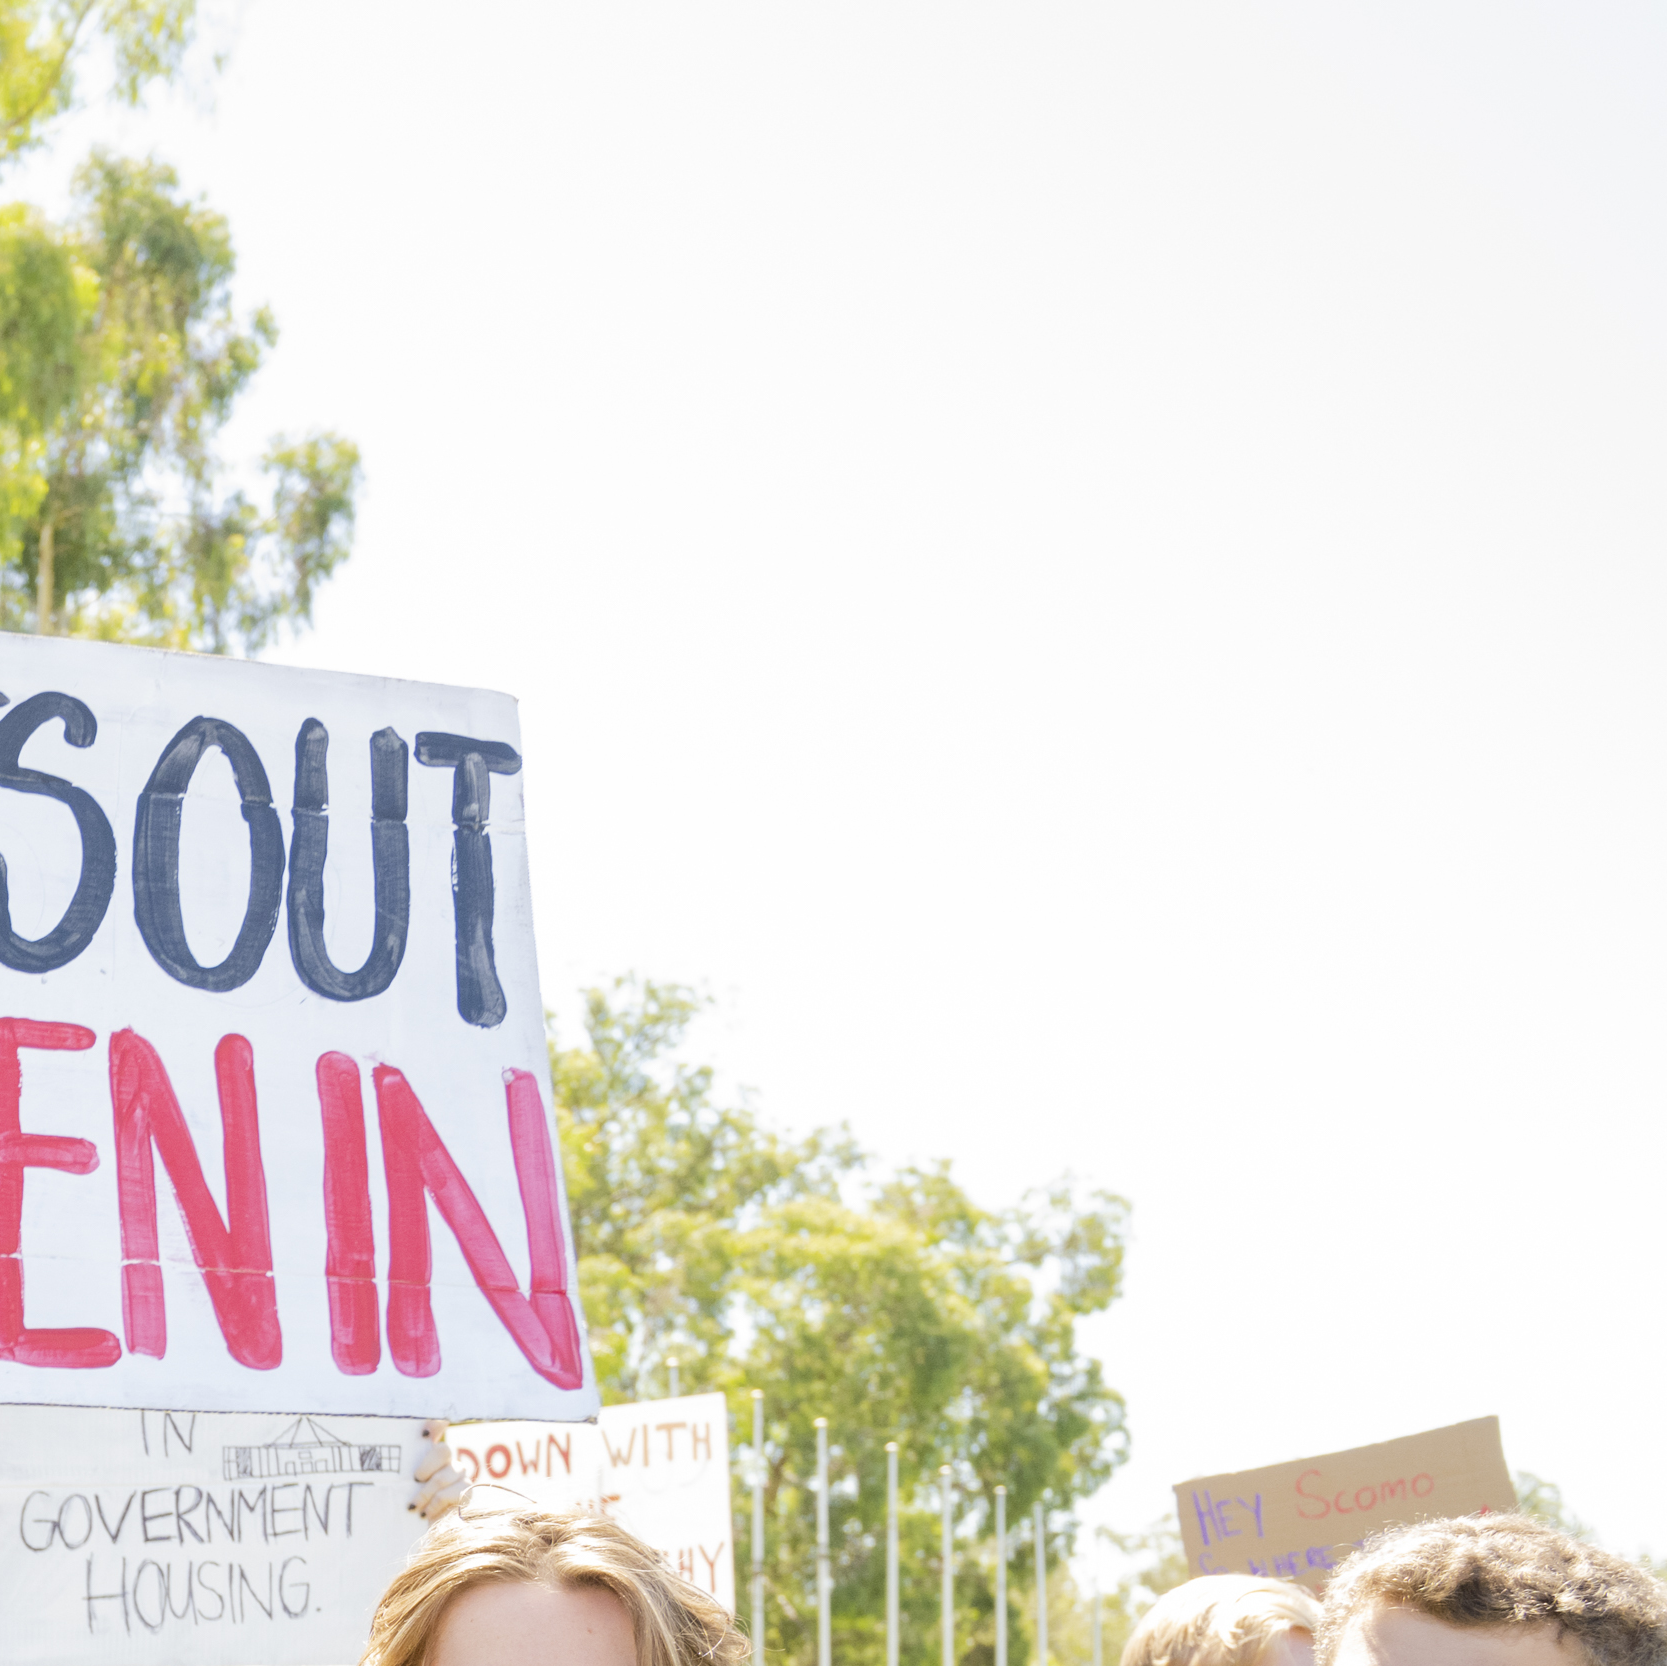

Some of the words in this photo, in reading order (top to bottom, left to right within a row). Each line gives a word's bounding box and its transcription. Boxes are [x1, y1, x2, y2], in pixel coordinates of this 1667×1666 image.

[132, 714, 522, 1029] OUT
[316, 1050, 584, 1391] IN
[141, 1409, 196, 1457] IN
[457, 1432, 571, 1483] DOWN
[602, 1421, 713, 1468] WITH
[20, 1482, 375, 1552] GOVERNMENT
[1191, 1489, 1264, 1547] HEY
[82, 1553, 322, 1637] HOUSING.
